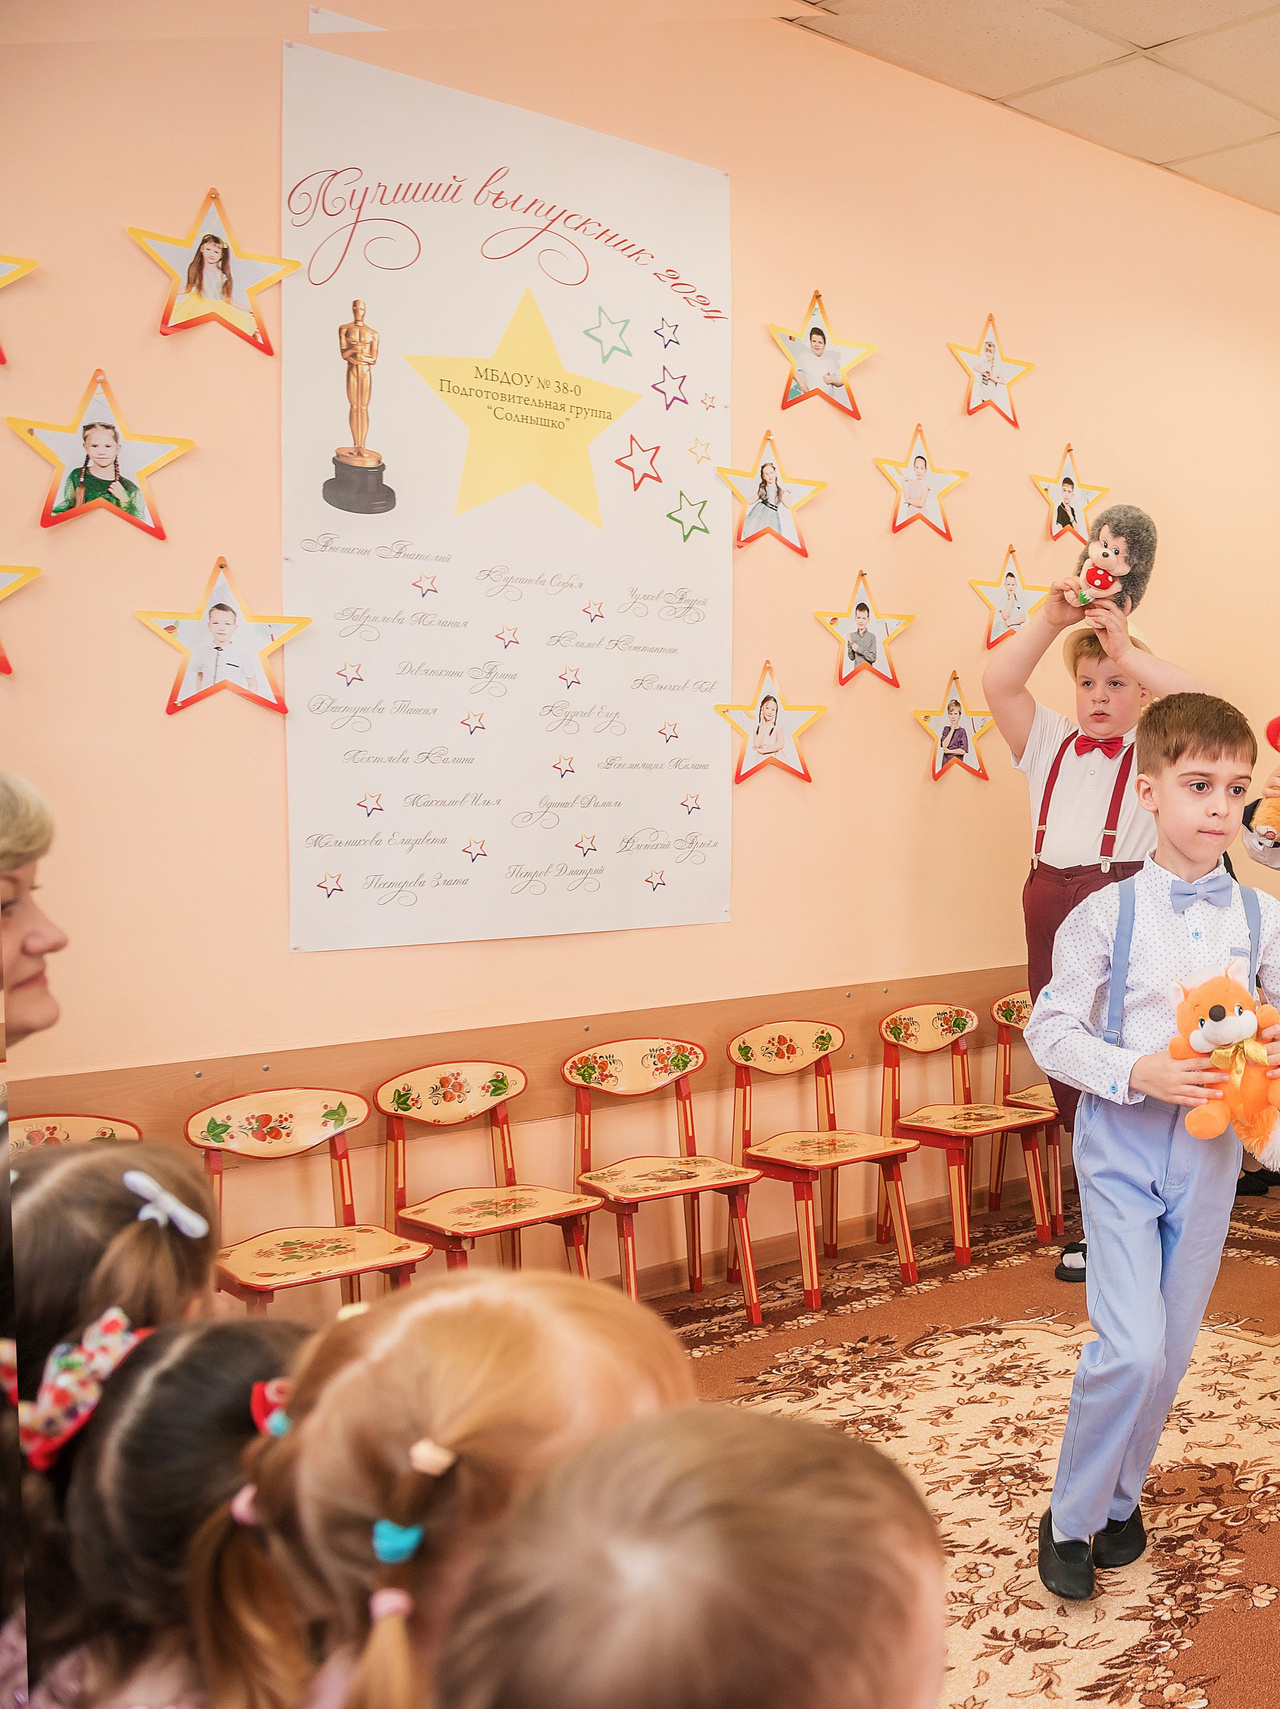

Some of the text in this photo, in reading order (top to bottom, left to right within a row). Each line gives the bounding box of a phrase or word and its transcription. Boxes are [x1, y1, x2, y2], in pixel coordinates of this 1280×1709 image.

[287, 165, 730, 323] Лучший выпускник 2024
[474, 366, 582, 396] МБДОУ № 38-0
[439, 379, 612, 420] Подготовительная группа
[300, 533, 453, 563] Аношкин Анатолий
[334, 607, 468, 641] Гаврилова Мелания
[396, 661, 518, 697] Девяткина Арина
[402, 793, 470, 808] Максимов
[304, 831, 448, 854] Мельникова Елизавета
[362, 872, 470, 907] Пестерева Злата
[505, 863, 606, 895] Петров Дмитрий
